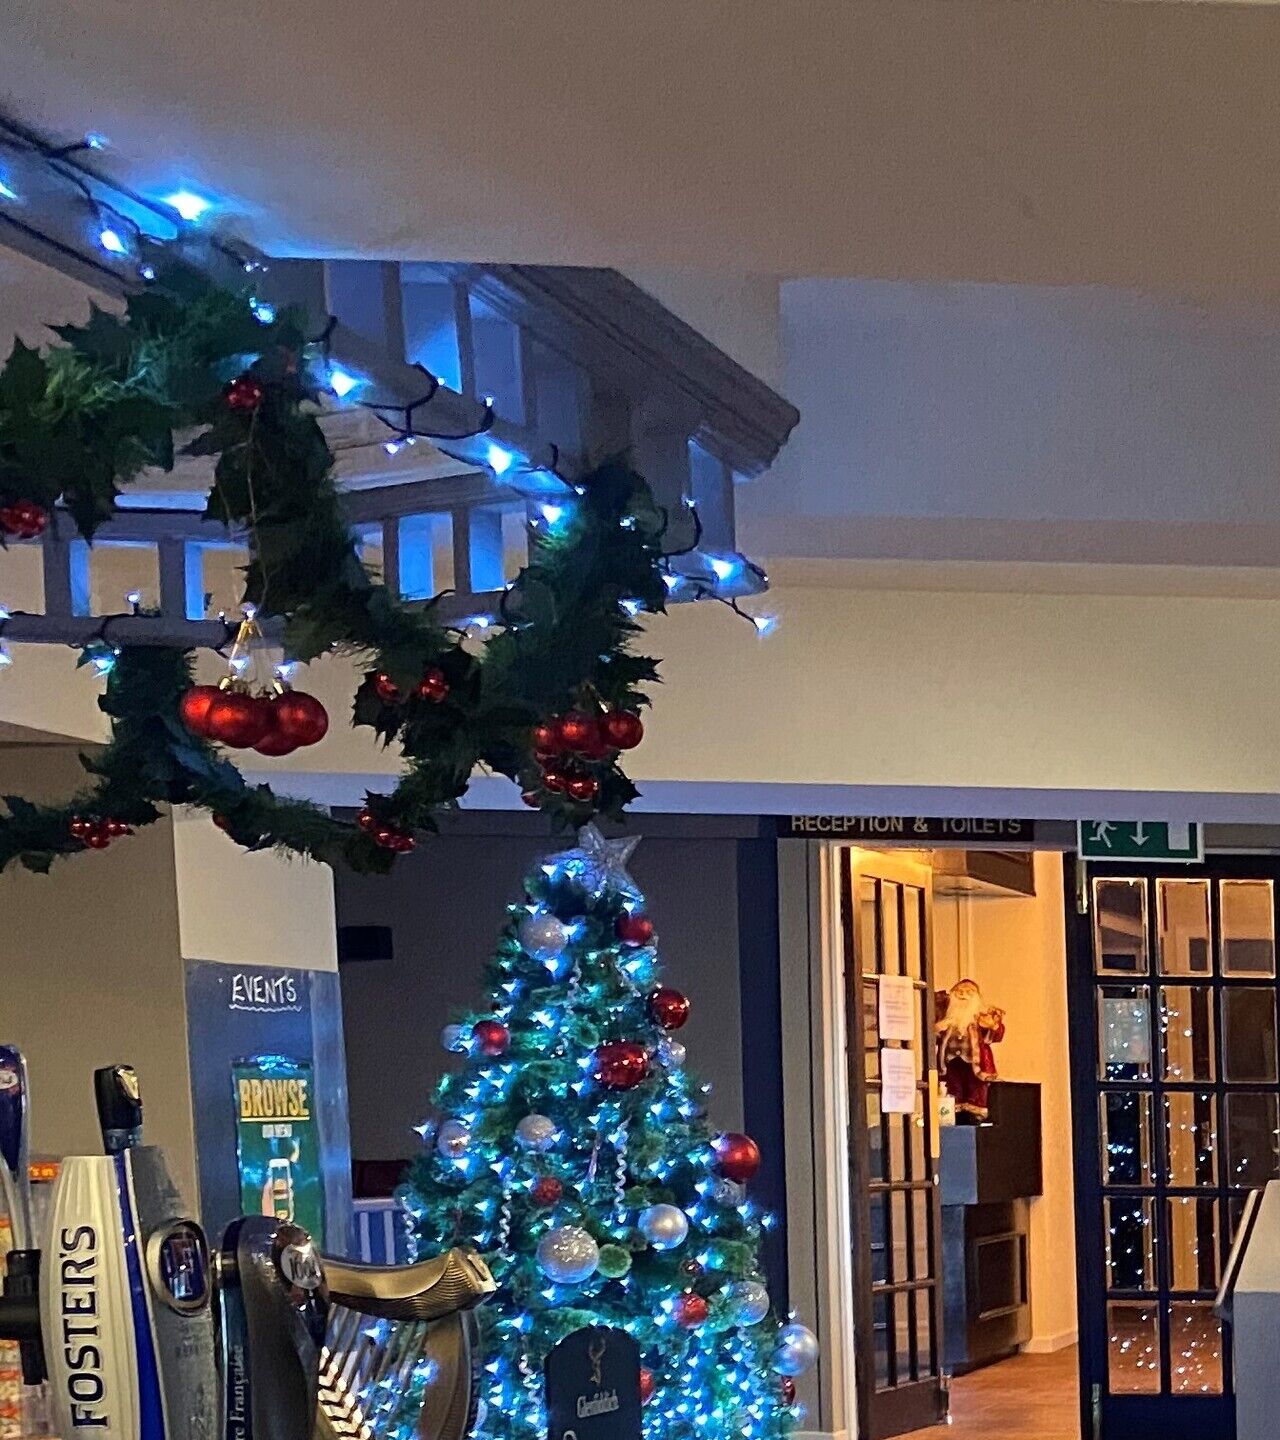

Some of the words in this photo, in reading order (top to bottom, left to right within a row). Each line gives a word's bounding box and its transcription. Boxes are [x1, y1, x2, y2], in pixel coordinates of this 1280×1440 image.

[791, 815, 903, 832] RECEPTION
[913, 816, 928, 833] &
[941, 818, 1021, 834] TOILETS
[232, 973, 297, 1004] EVENTS
[239, 1079, 309, 1117] BROWSE
[60, 1226, 108, 1428] FOSTER'S
